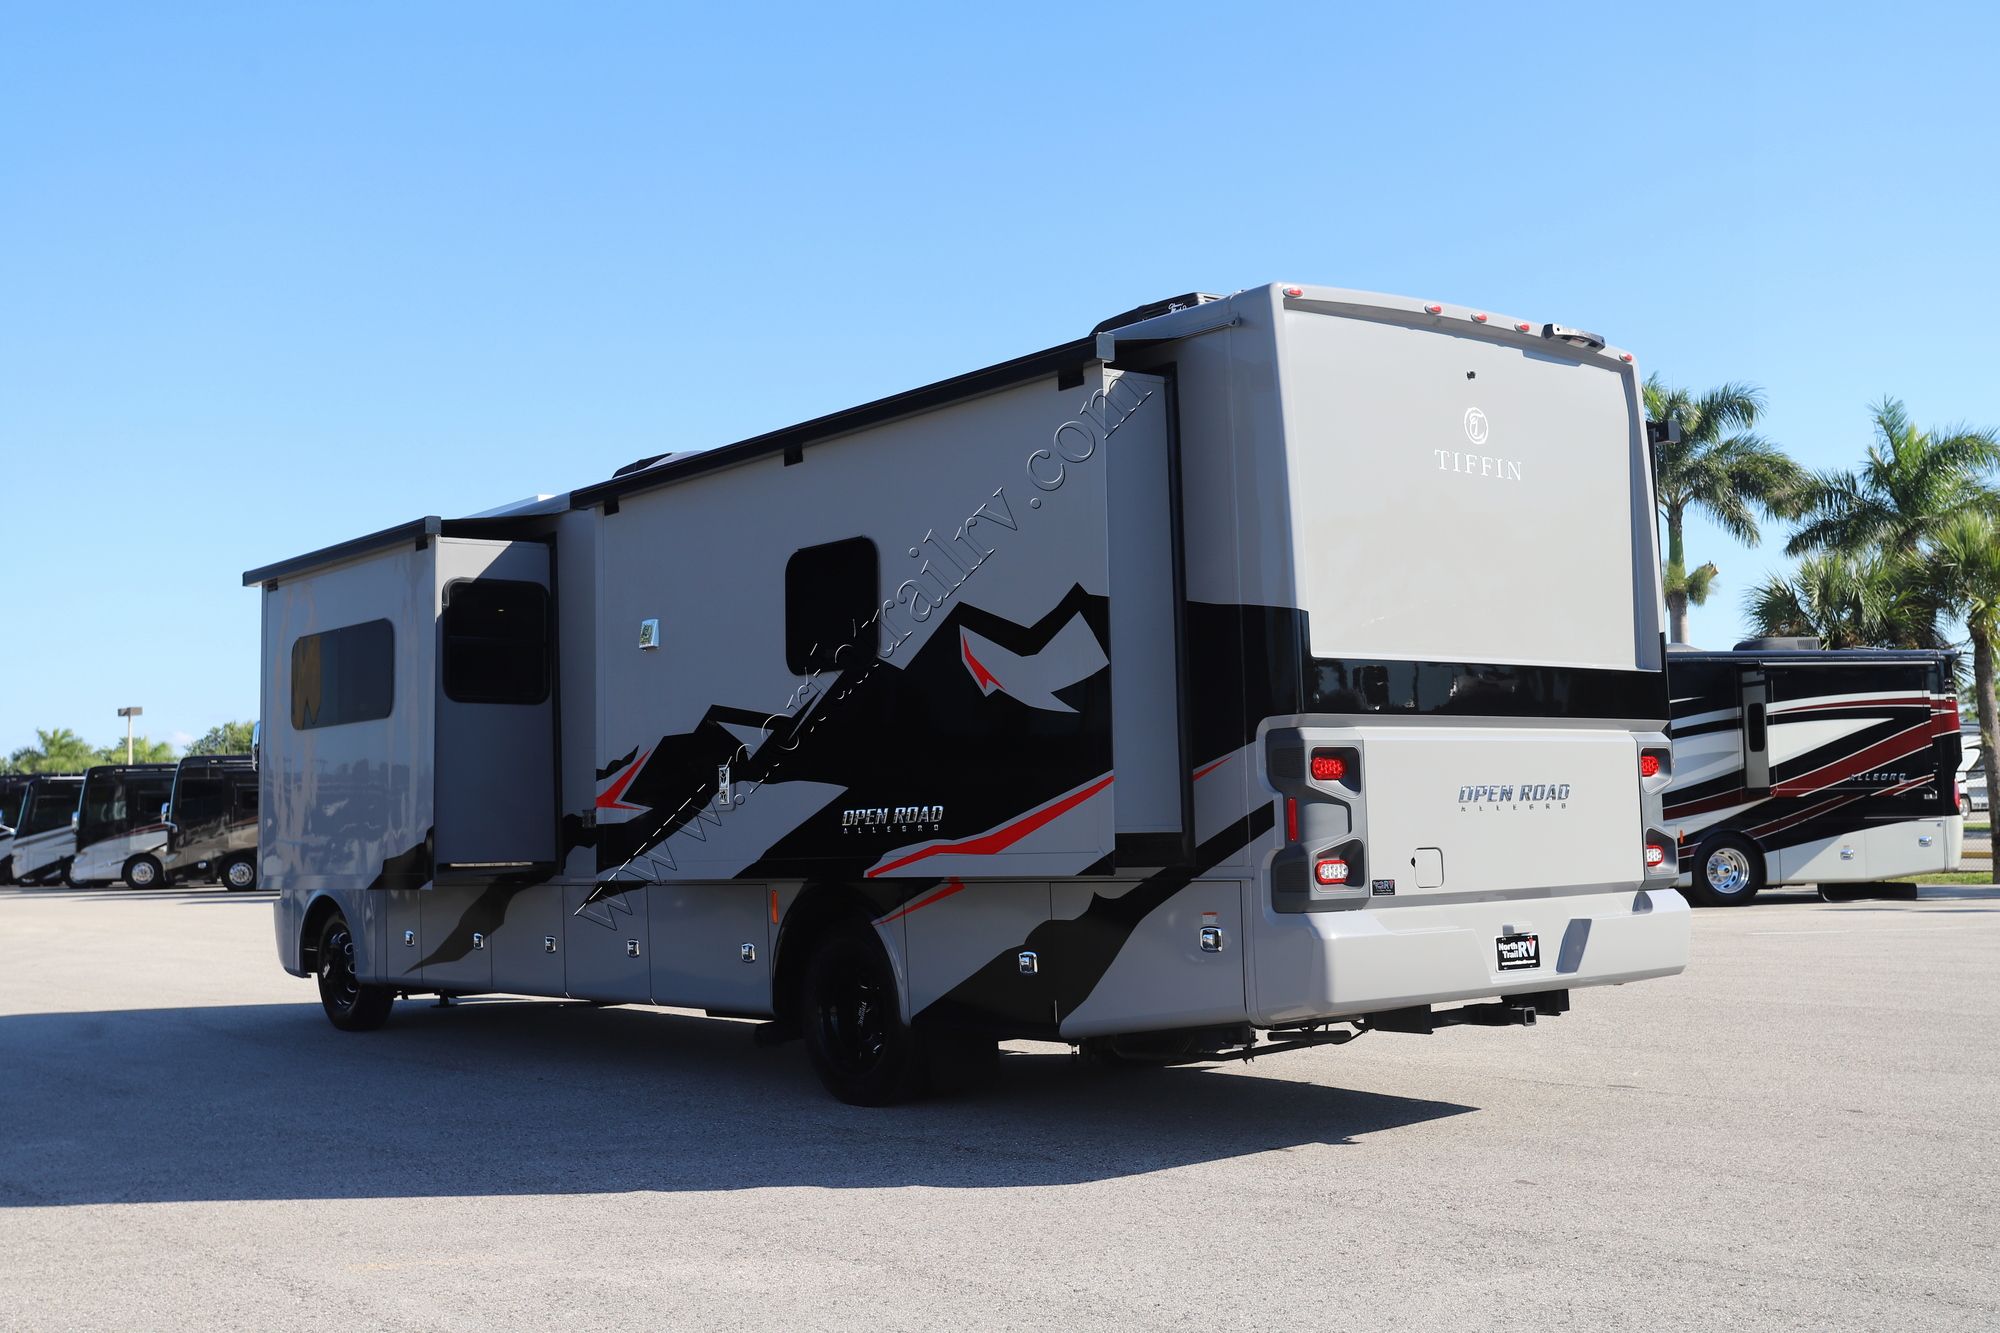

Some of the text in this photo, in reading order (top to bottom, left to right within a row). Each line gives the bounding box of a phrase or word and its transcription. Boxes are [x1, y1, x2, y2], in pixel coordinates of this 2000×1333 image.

[1434, 448, 1522, 481] TIFFIN
[1848, 772, 1907, 781] ALLEGRO
[1458, 783, 1571, 803] OPEN ROAD
[842, 805, 944, 826] OPEN ROAD
[843, 824, 939, 834] ALLEGRO
[1498, 941, 1518, 951] North
[1517, 940, 1536, 958] RV
[1502, 949, 1518, 959] Trail
